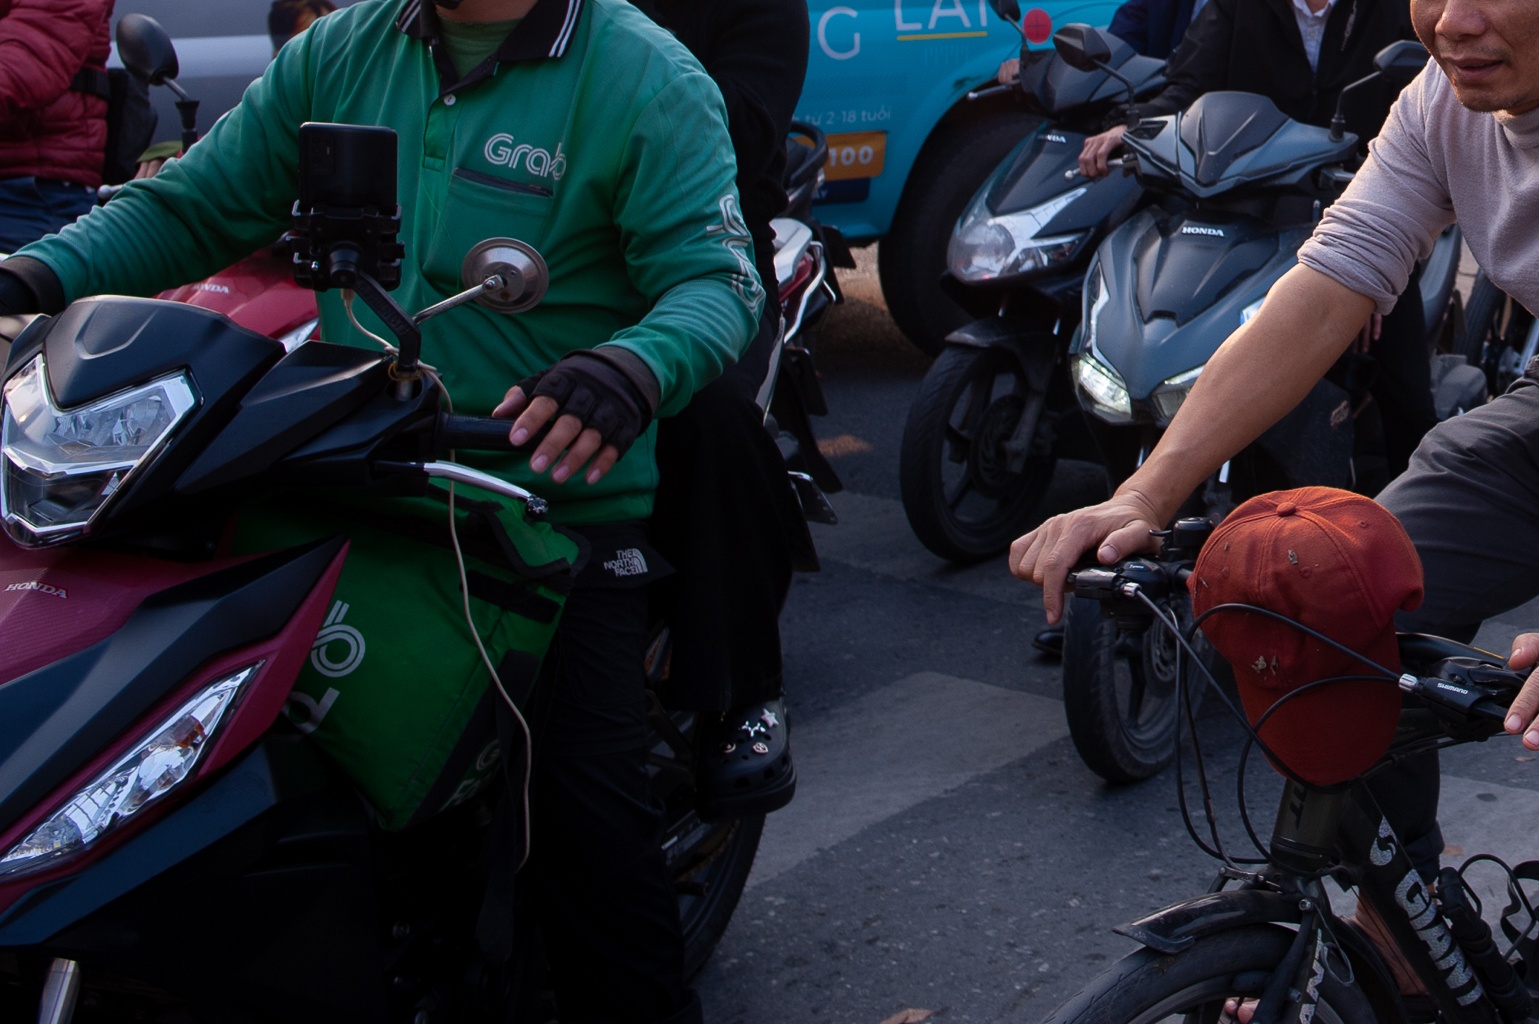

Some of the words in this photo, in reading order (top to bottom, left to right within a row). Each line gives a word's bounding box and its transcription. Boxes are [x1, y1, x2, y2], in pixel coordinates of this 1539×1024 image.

[484, 131, 568, 181] Grab
[1182, 226, 1225, 237] HONDA
[616, 549, 634, 559] THE
[603, 557, 636, 570] NORTH
[614, 565, 638, 577] FACE
[4, 580, 67, 599] HONDA
[1437, 682, 1469, 695] SHIMANO
